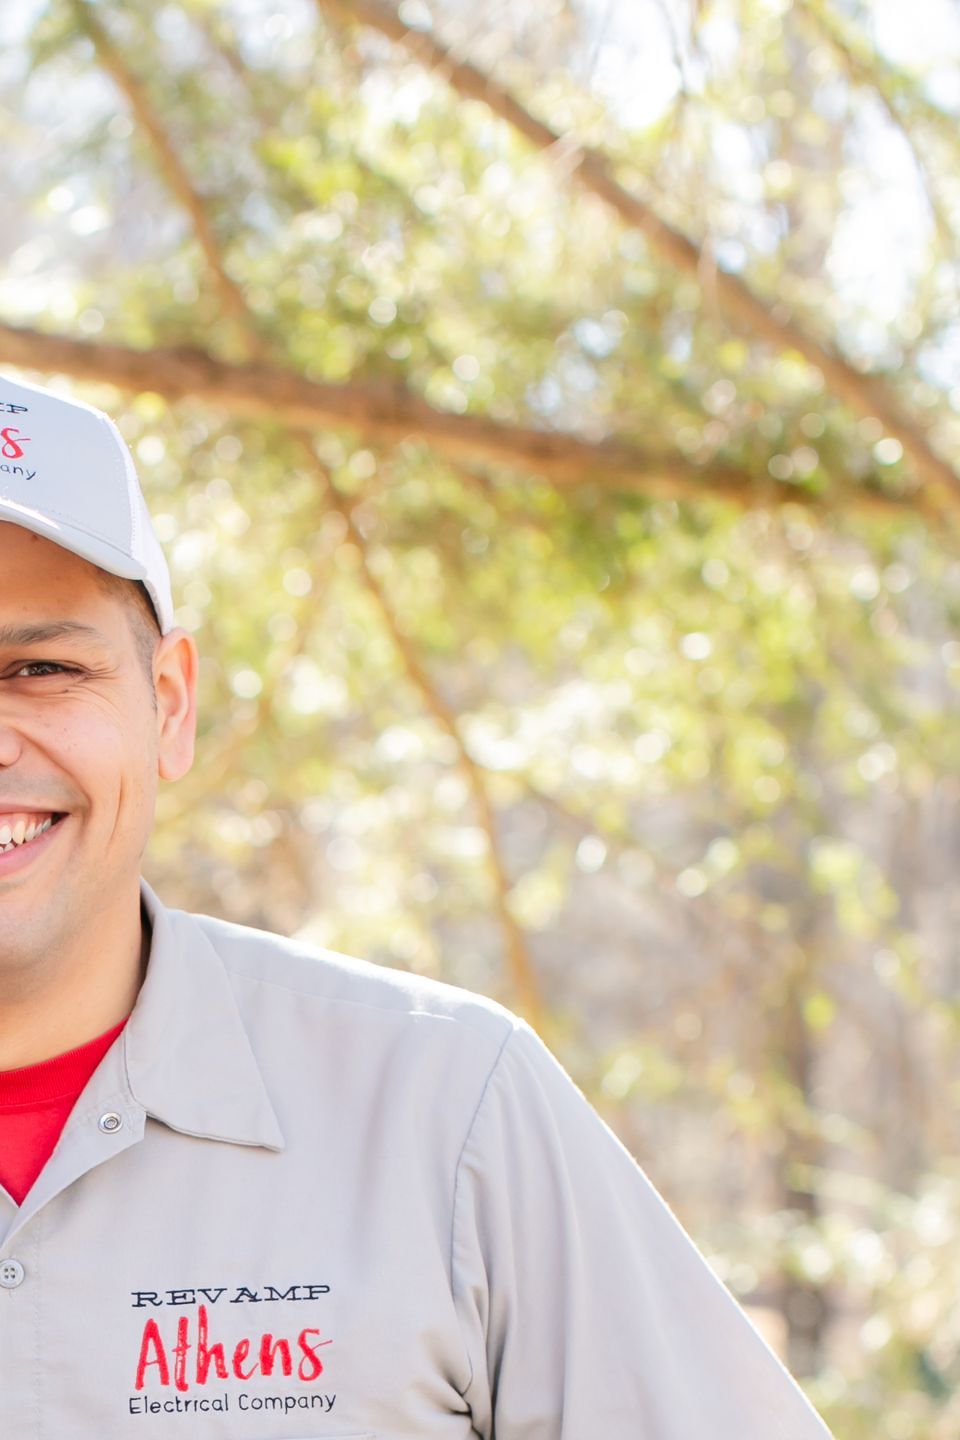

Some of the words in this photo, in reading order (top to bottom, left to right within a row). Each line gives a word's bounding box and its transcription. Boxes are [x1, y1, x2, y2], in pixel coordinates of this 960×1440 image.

[130, 1284, 331, 1308] REVAMP
[134, 1303, 333, 1392] Athens
[128, 1393, 229, 1415] Electrical
[237, 1393, 337, 1415] Company
